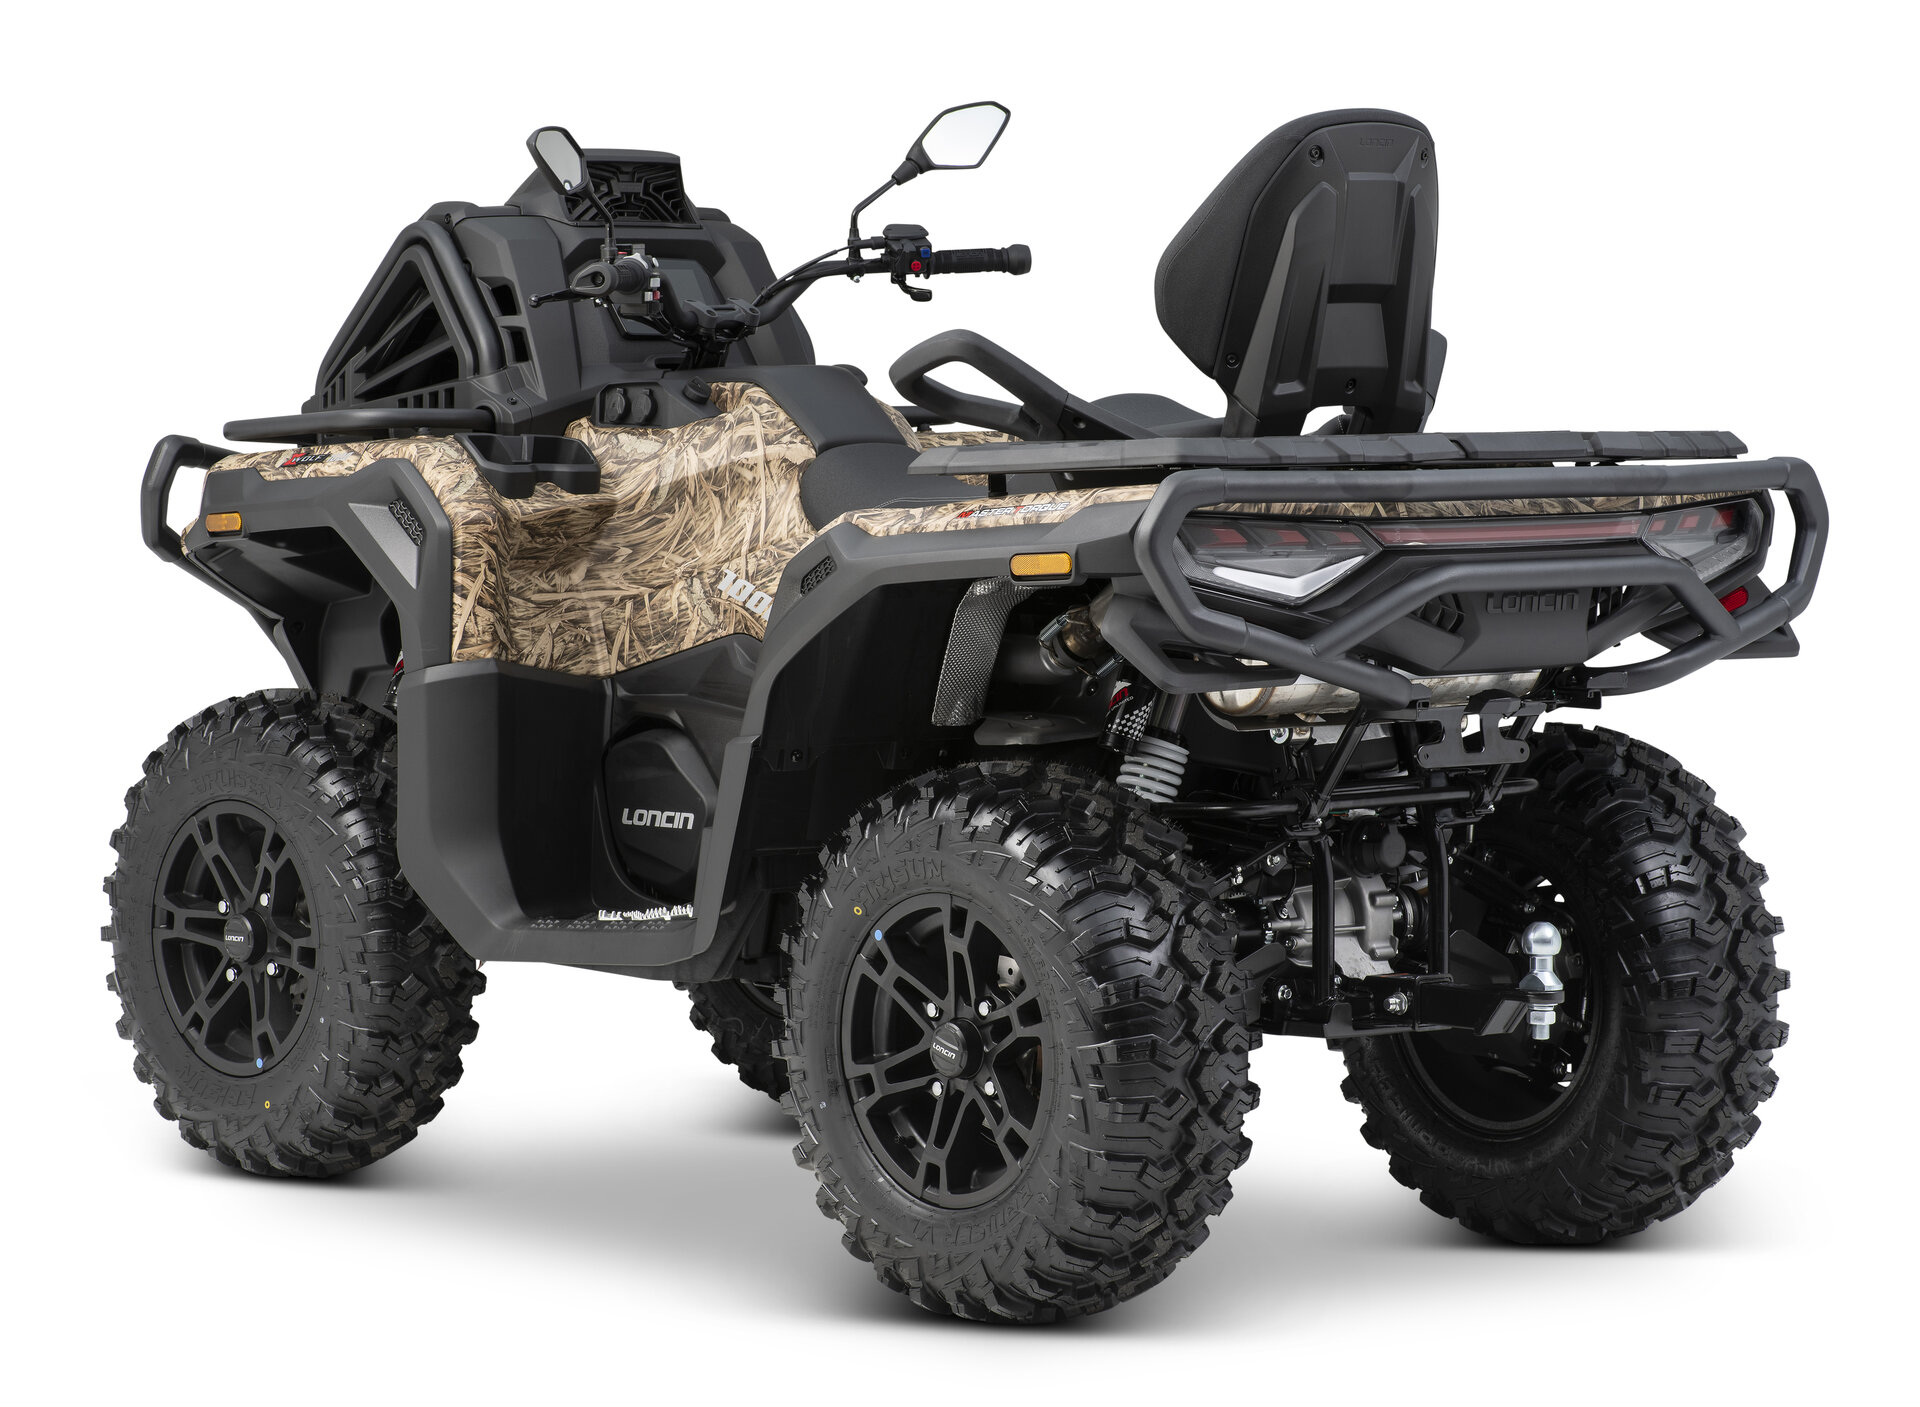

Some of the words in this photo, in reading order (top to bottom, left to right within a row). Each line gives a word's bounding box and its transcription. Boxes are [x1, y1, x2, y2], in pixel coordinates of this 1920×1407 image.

[717, 568, 773, 621] 100
[1486, 590, 1580, 614] LONCIN
[621, 808, 695, 830] LONCIN
[932, 1042, 956, 1060] LONCIN
